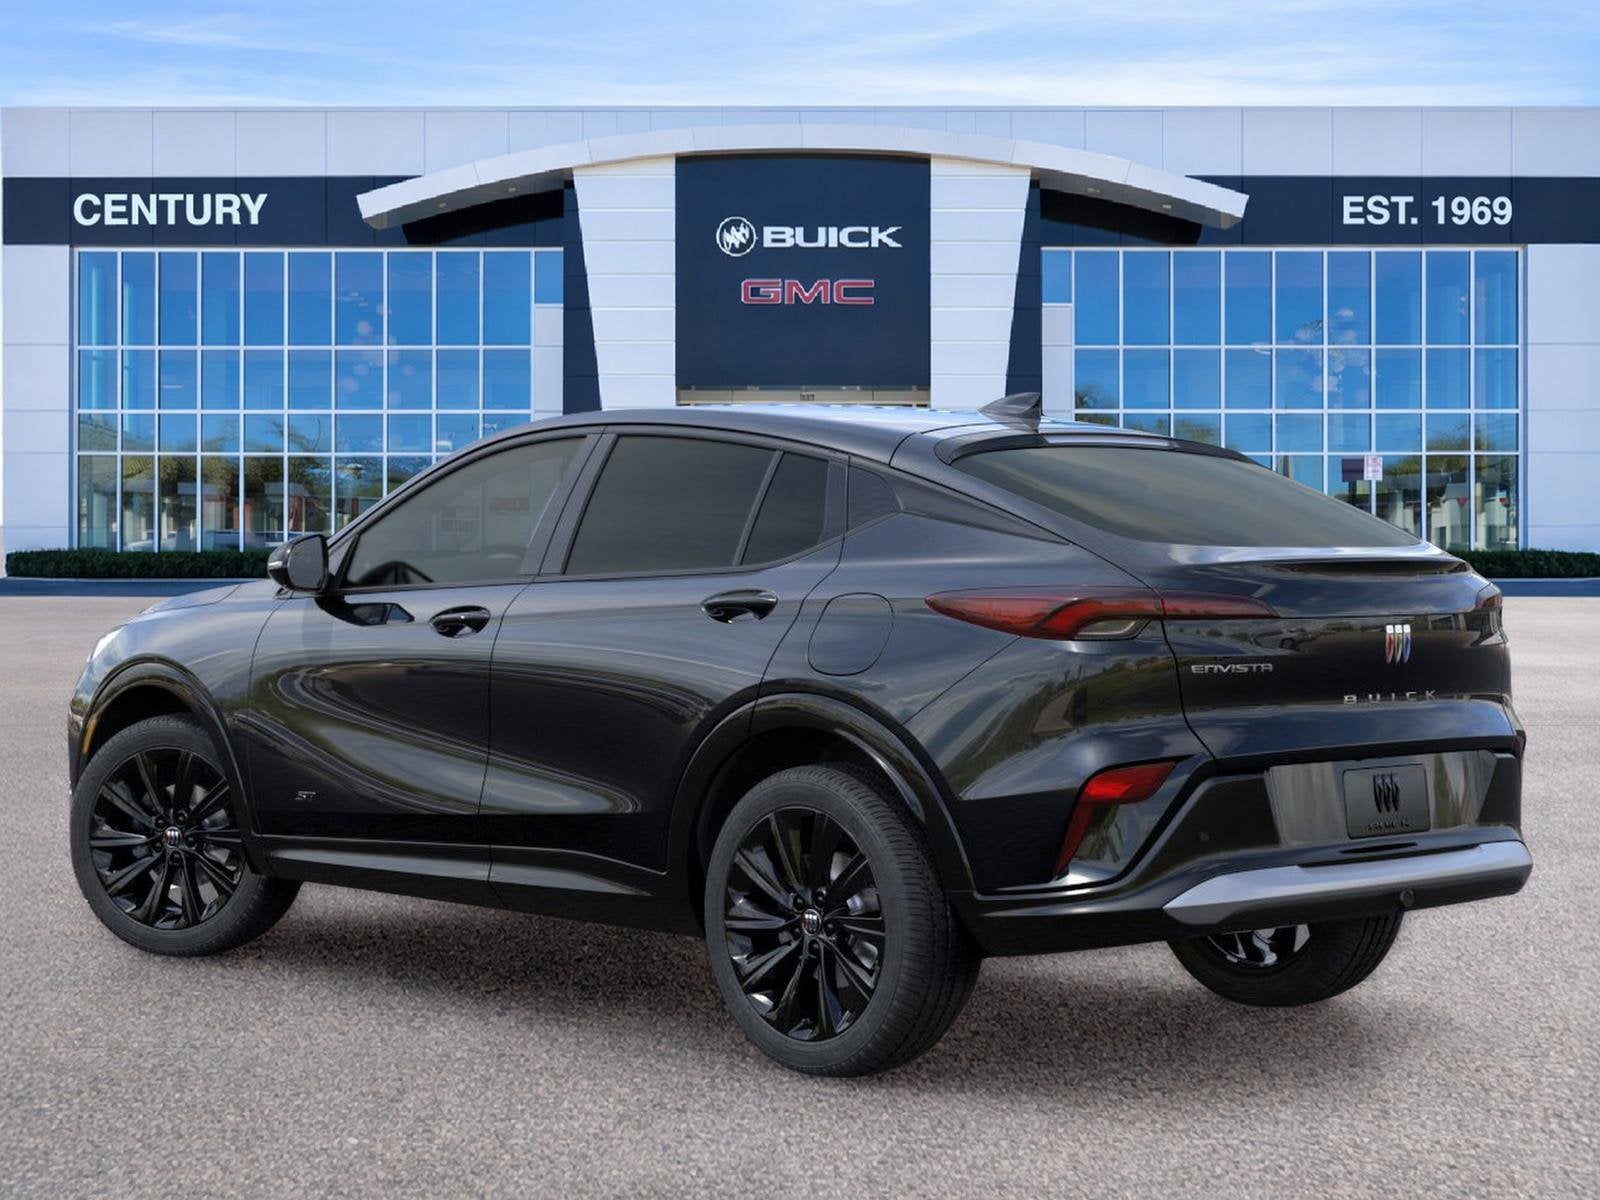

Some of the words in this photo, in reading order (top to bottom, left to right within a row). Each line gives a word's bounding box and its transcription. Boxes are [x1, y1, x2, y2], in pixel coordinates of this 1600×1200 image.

[73, 193, 268, 226] CENTURY
[1342, 195, 1418, 225] EST.
[1431, 196, 1513, 225] 1969
[763, 226, 903, 248] BUICK
[741, 279, 875, 305] GMC
[1191, 663, 1274, 674] ENVISTA
[1343, 690, 1437, 704] BUICK
